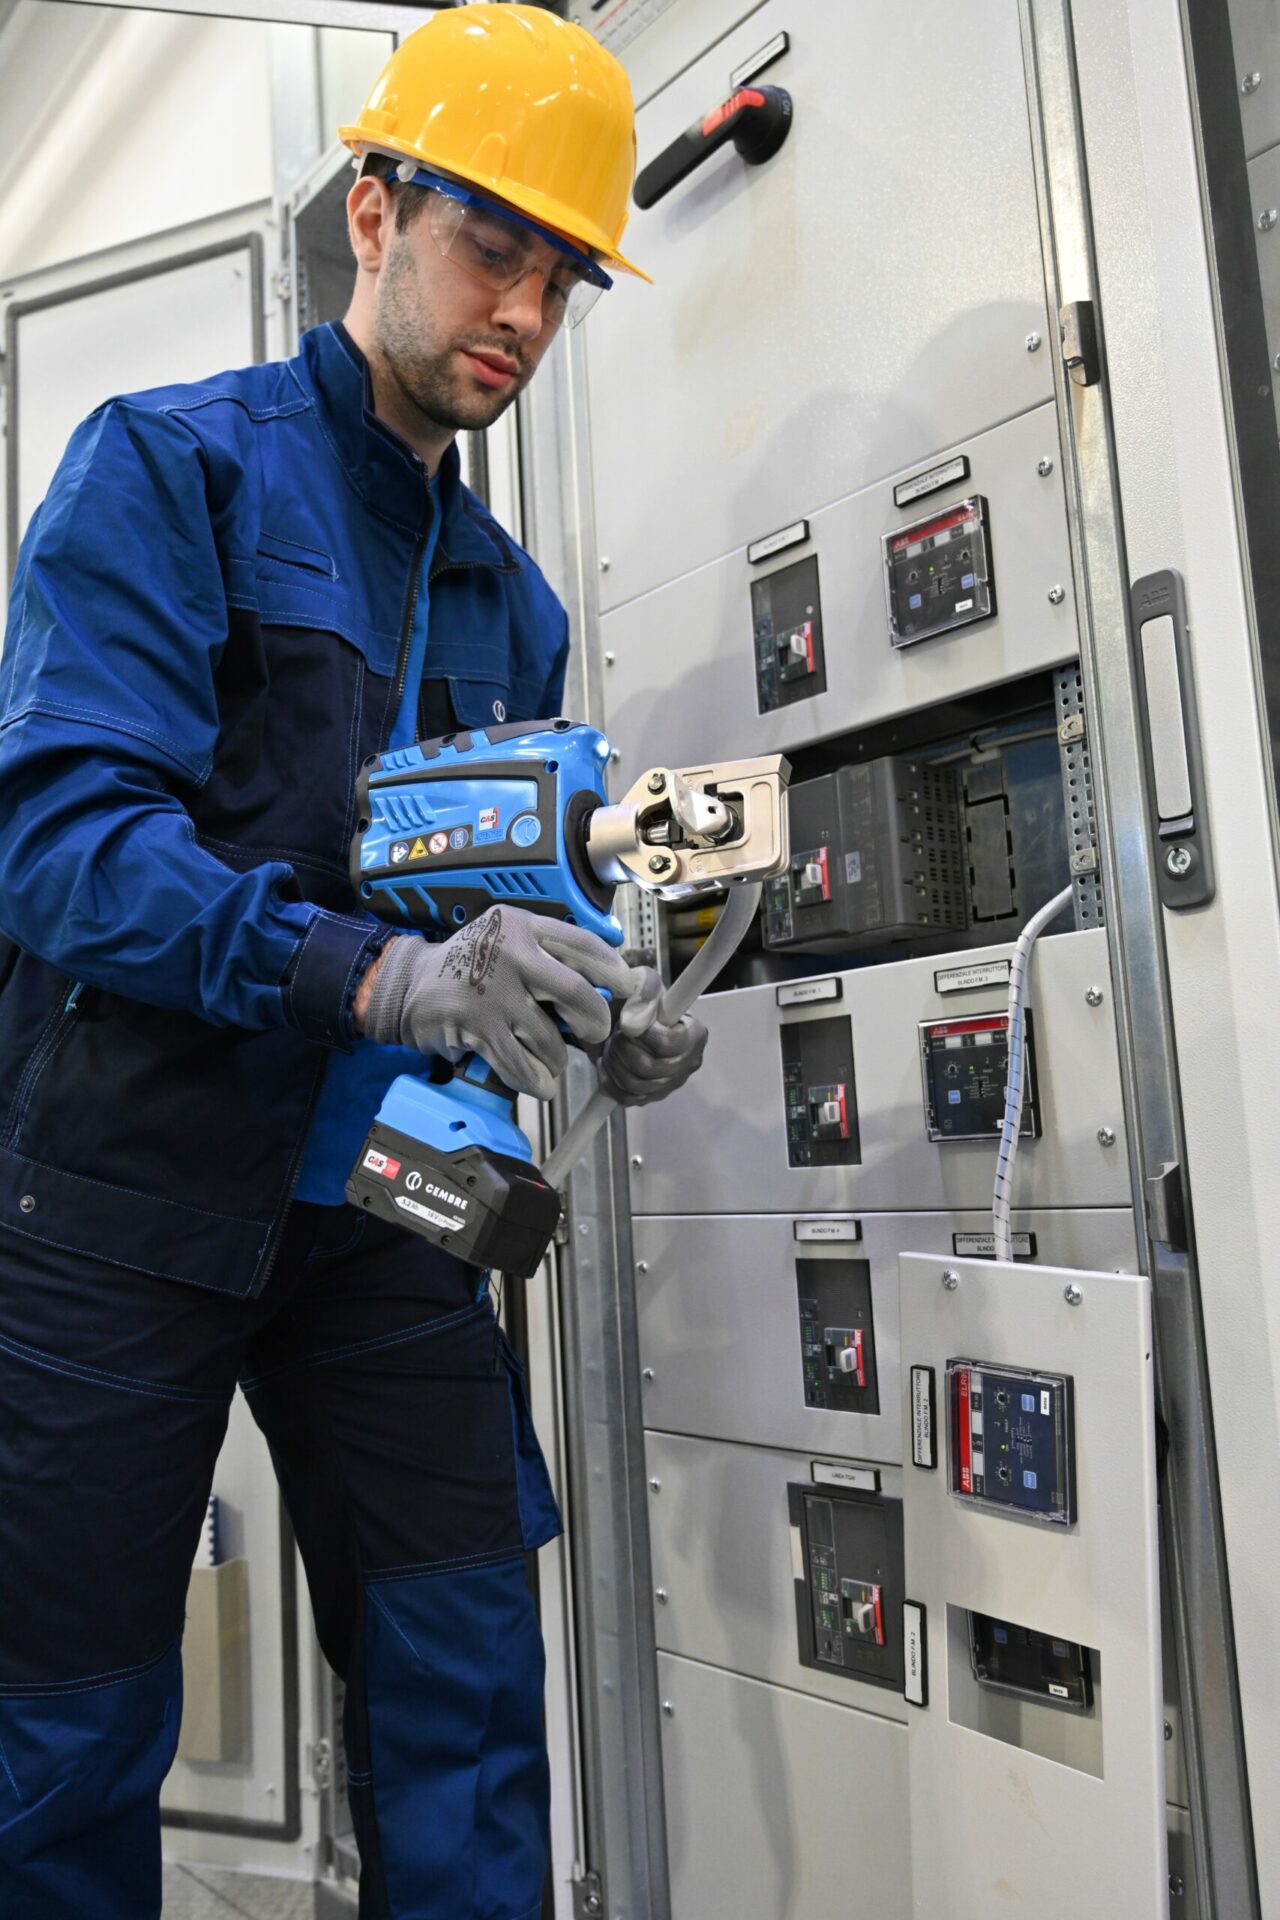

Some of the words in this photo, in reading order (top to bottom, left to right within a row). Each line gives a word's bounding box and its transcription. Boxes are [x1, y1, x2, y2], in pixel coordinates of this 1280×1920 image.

[481, 814, 495, 823] CAS
[937, 970, 971, 981] DIFFERENZIALE
[972, 964, 1008, 976] INTERRUTTORE
[957, 977, 975, 986] BLINDO
[368, 1155, 384, 1167] CAS
[425, 1183, 468, 1210] CEMBRE
[961, 1466, 970, 1489] ABB
